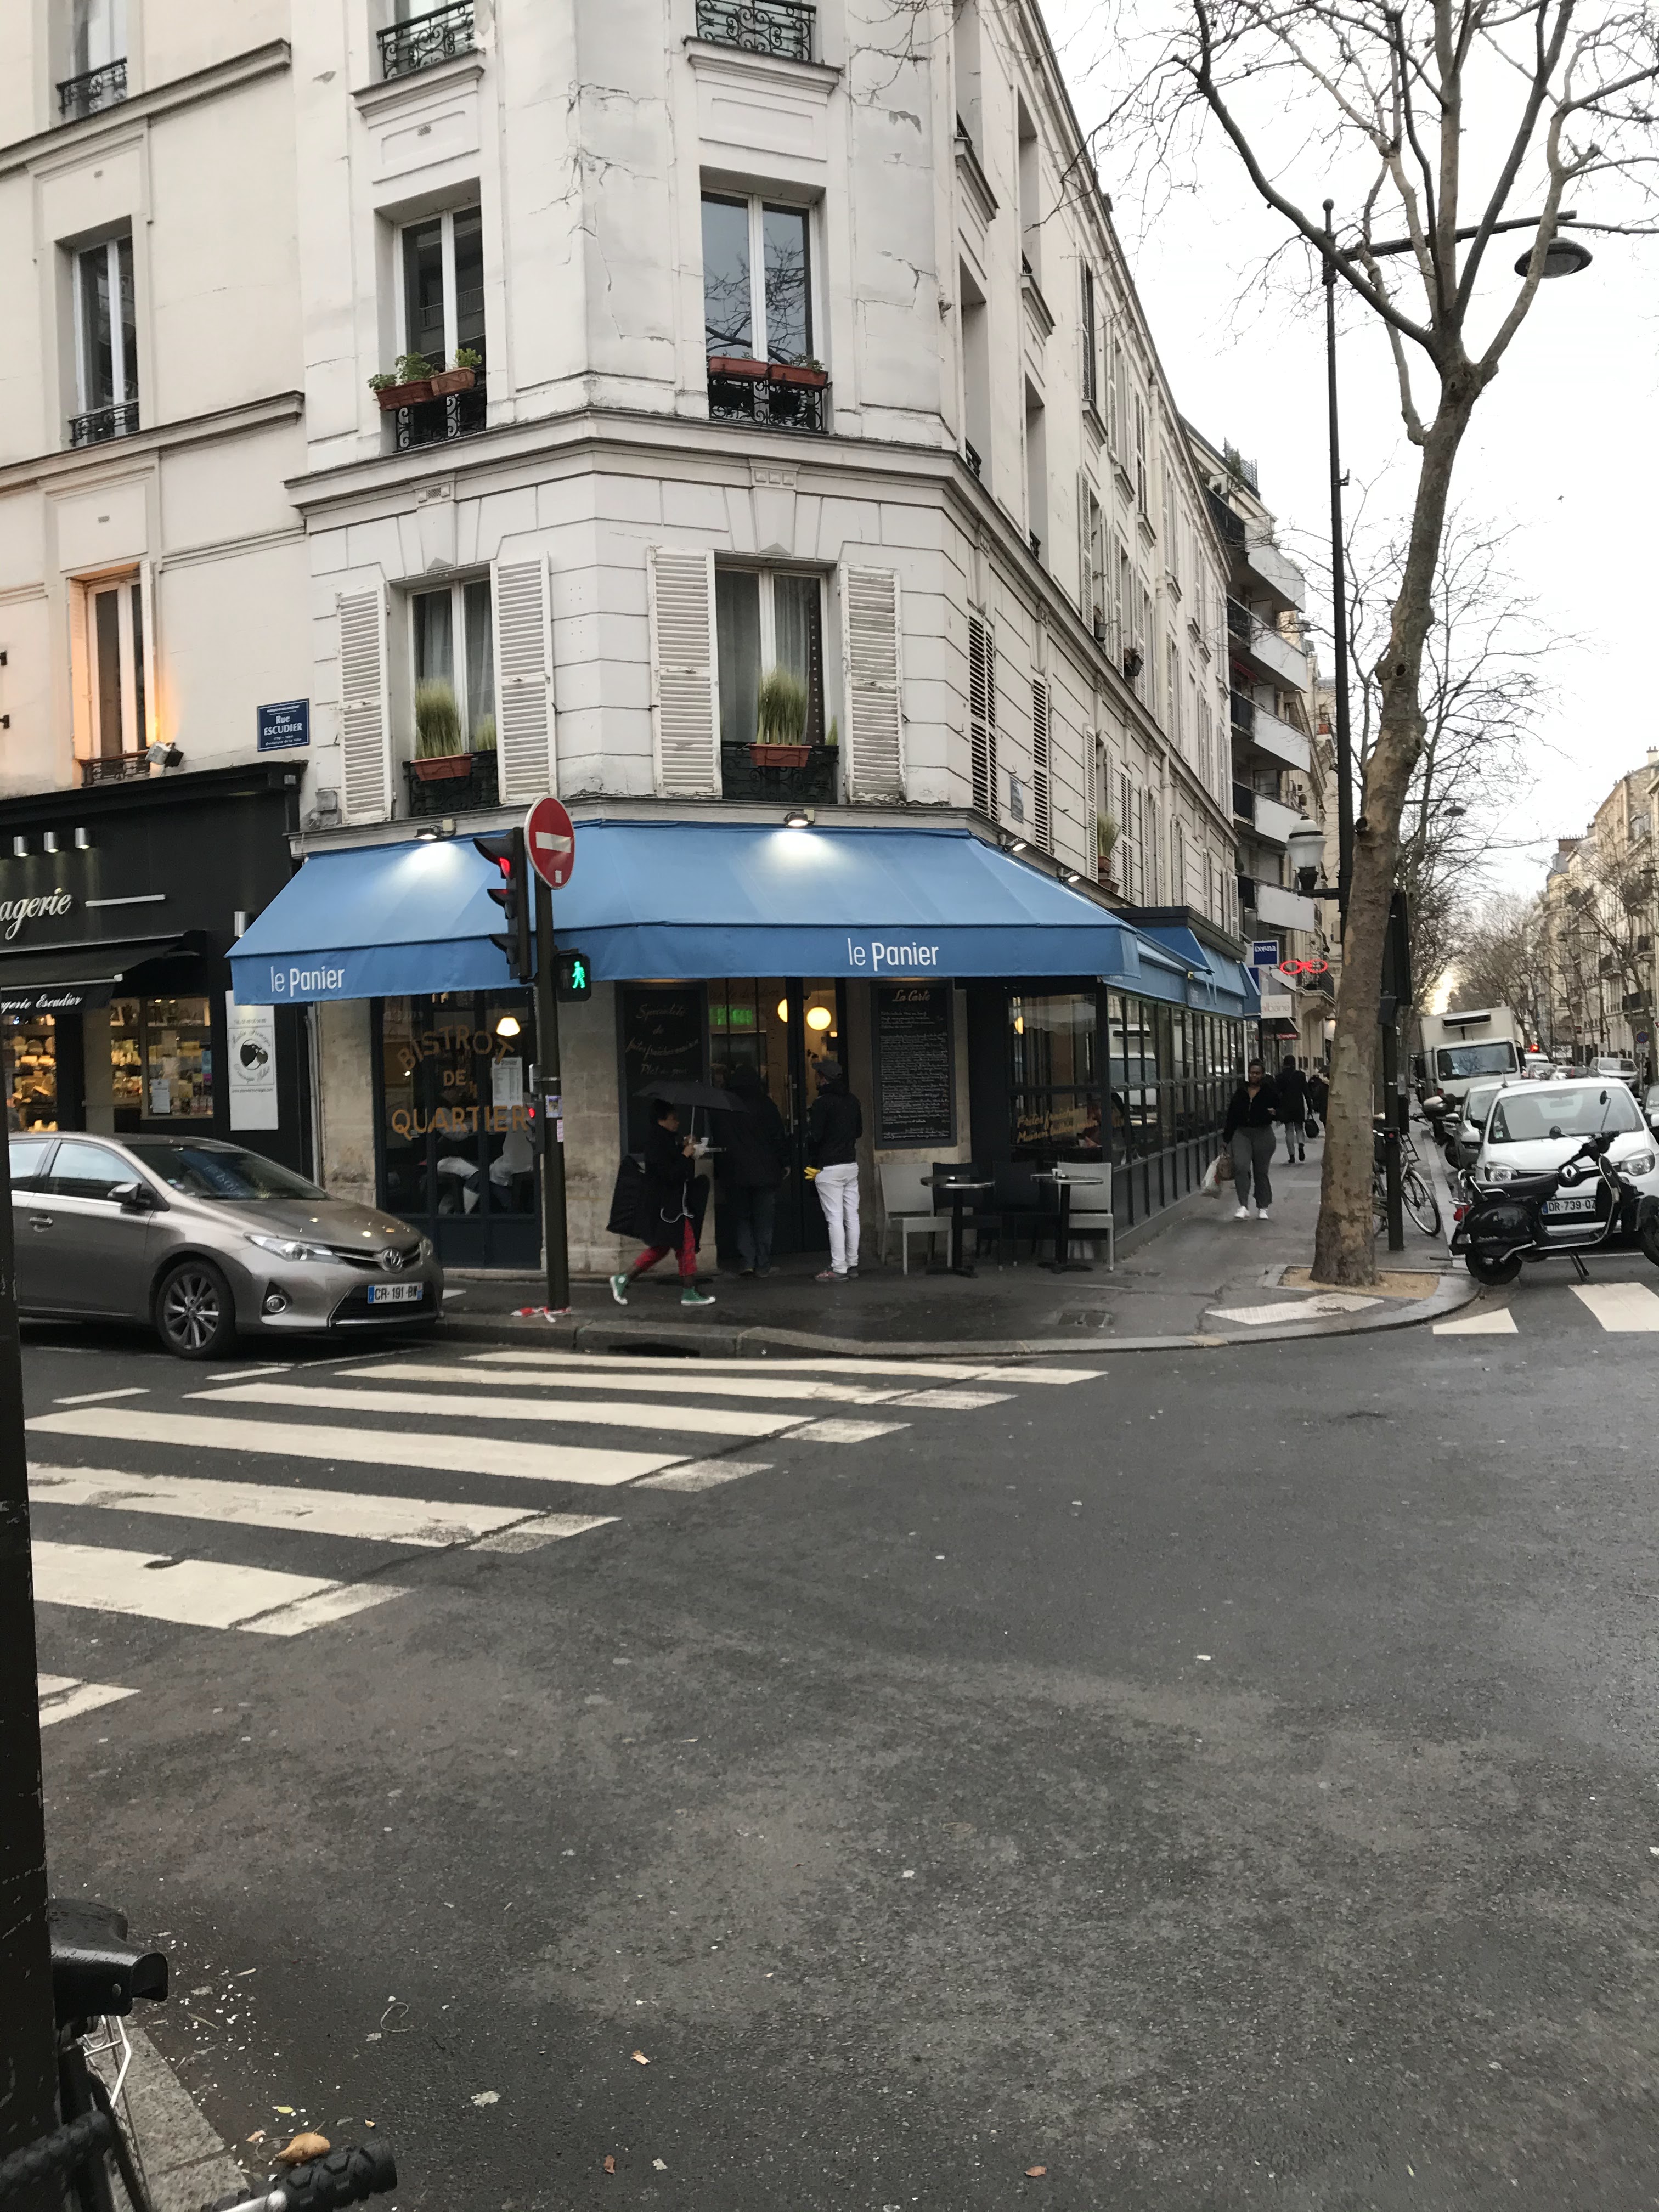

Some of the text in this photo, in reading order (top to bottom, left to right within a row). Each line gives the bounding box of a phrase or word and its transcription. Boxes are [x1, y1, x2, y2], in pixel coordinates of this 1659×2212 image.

[276, 715, 291, 724] Rue
[264, 723, 303, 736] ESCUDIER
[848, 937, 939, 972] le Panier
[270, 965, 346, 997] le Panier
[36, 992, 83, 1008] Escudier
[892, 989, 931, 1002] La Carte
[397, 1024, 516, 1065] BISTROT
[443, 1069, 467, 1087] DE
[391, 1104, 529, 1141] QUARTIER
